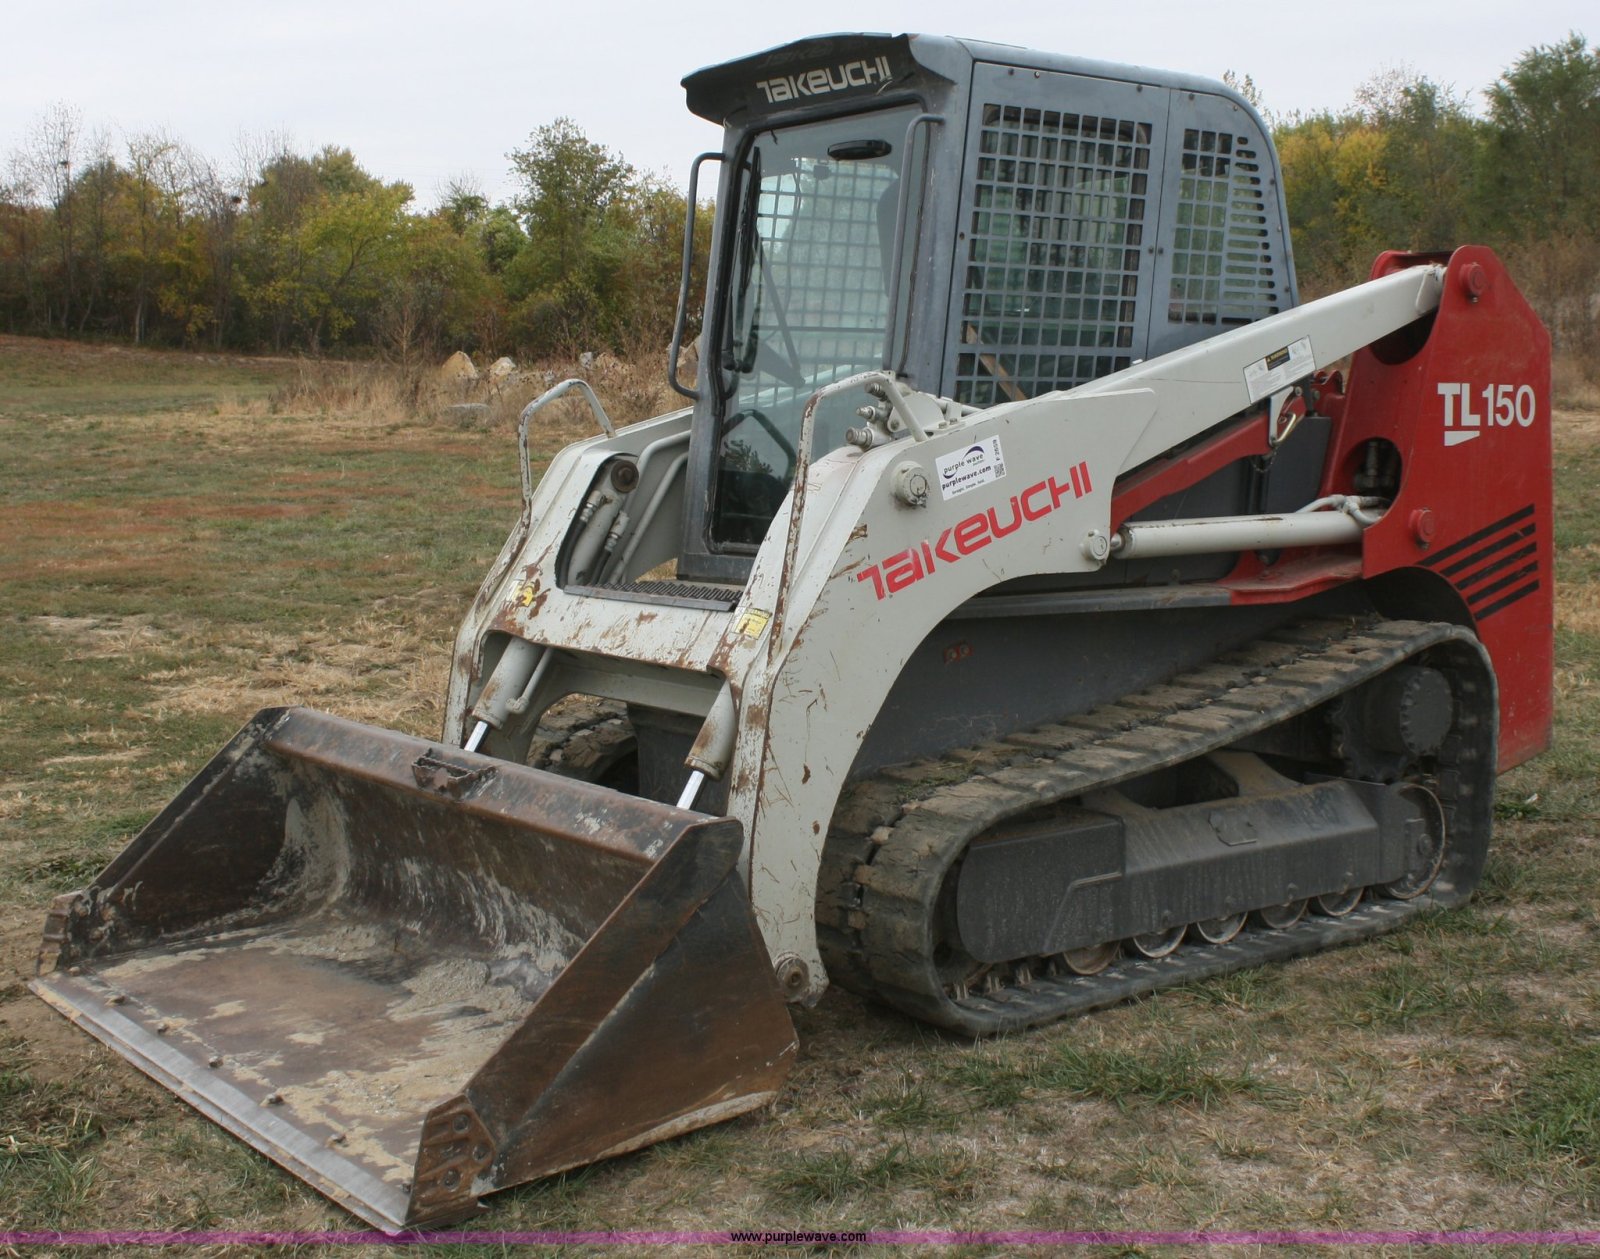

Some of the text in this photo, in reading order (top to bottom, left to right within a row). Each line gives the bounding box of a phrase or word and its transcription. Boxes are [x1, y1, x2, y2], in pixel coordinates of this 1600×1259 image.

[943, 460, 965, 475] purple
[966, 453, 984, 465] wave
[941, 465, 992, 491] purplewave.com
